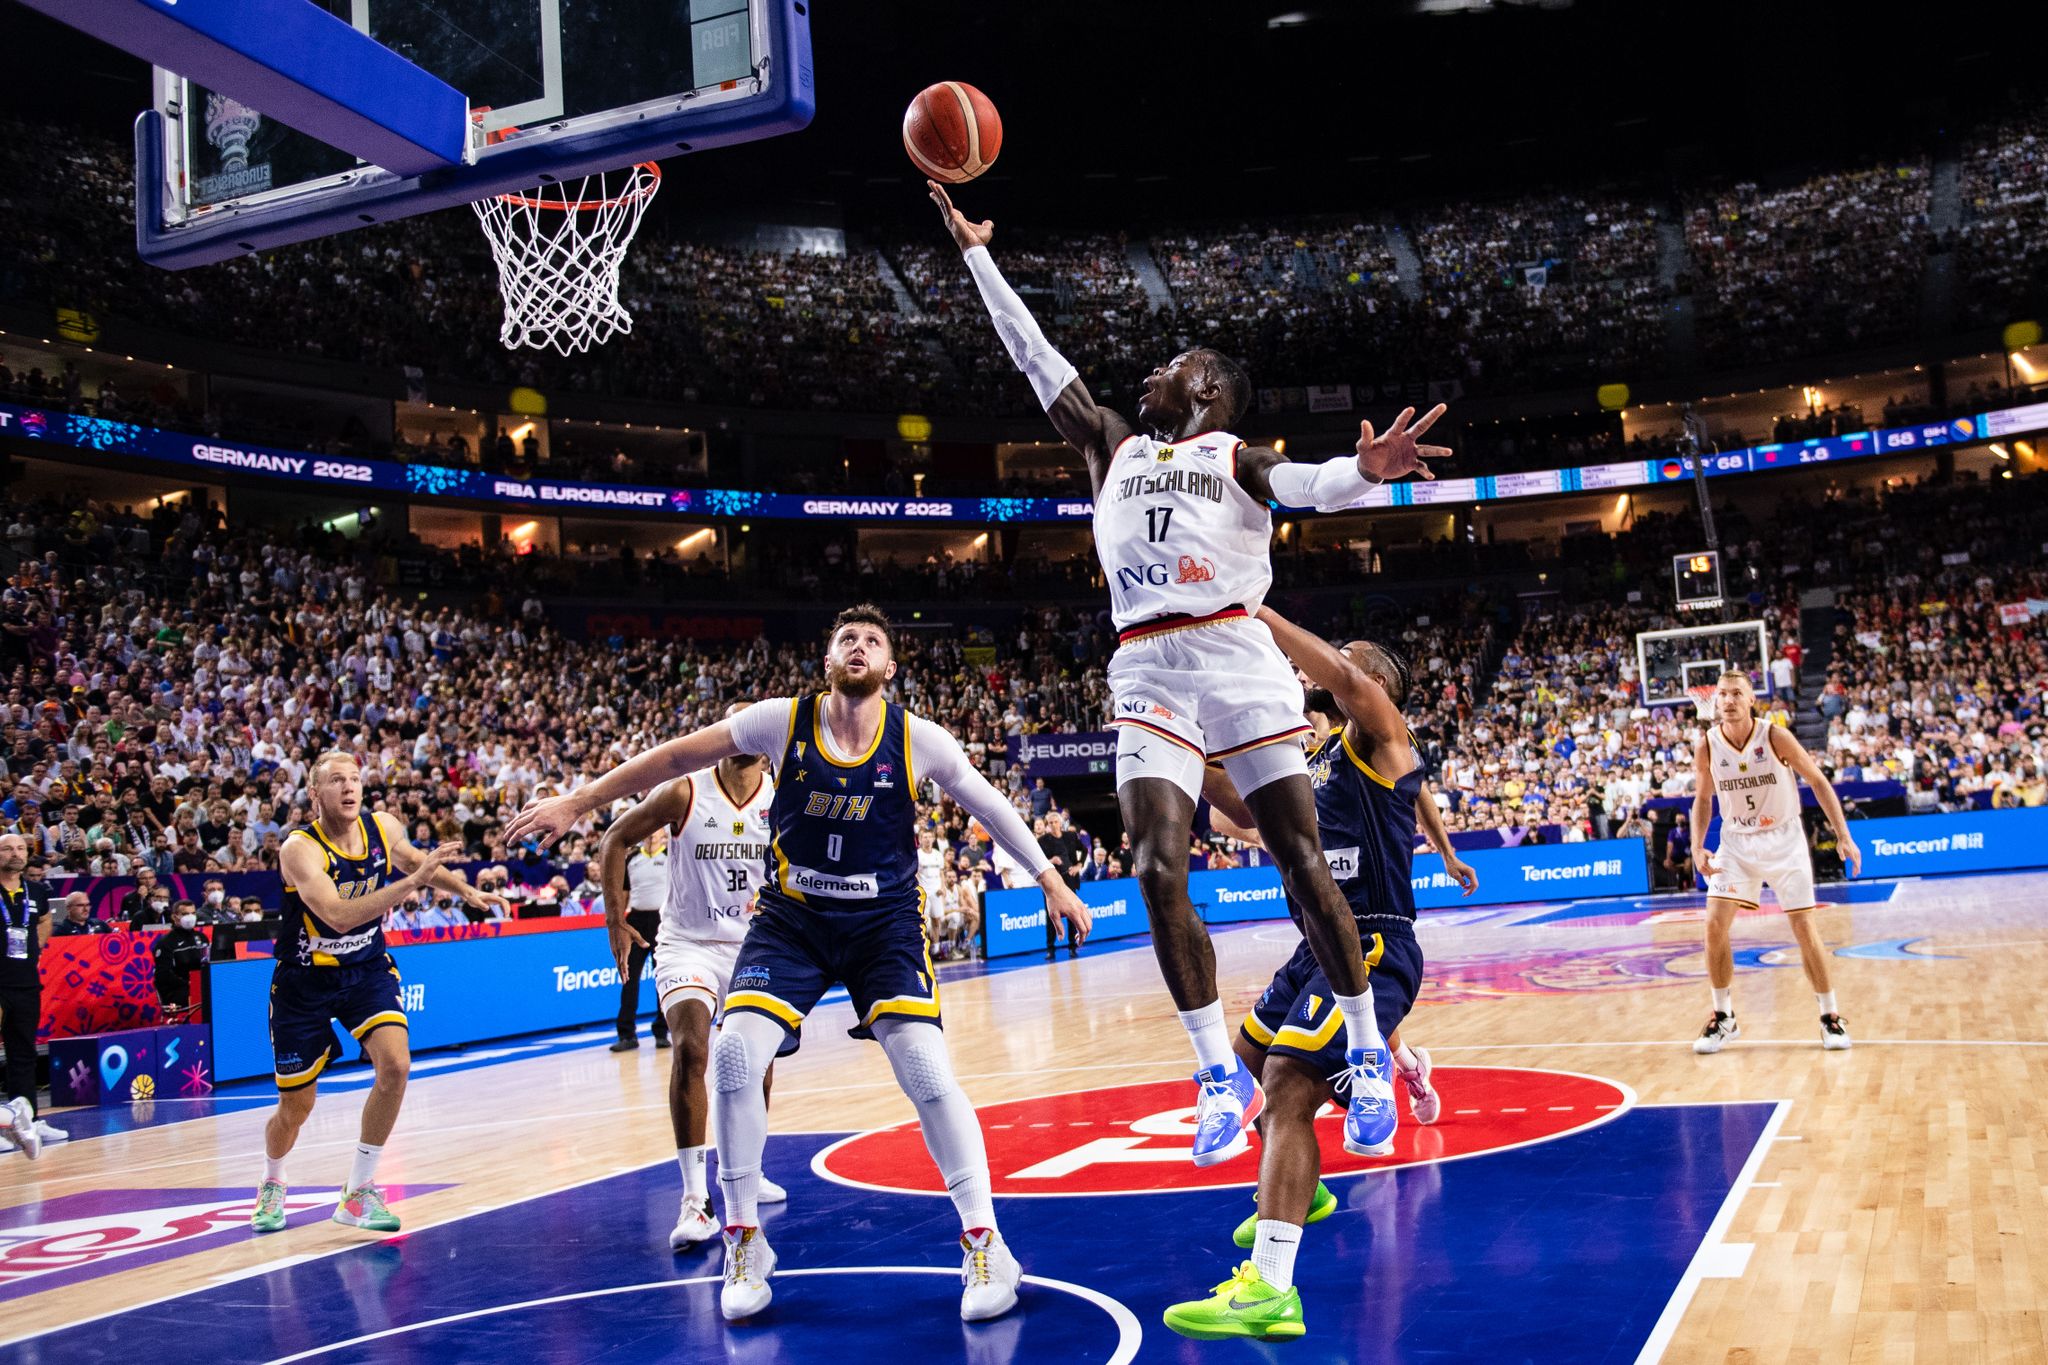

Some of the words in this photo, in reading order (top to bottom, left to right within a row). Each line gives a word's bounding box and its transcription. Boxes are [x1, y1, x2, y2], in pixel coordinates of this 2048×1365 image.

[192, 443, 306, 474] GERMANY
[312, 460, 373, 482] 2022
[494, 481, 536, 499] FIBA
[540, 486, 667, 506] EUROBASKET
[1117, 469, 1223, 504] EUTSCHLAND
[803, 500, 899, 517] GERMANY
[904, 502, 953, 517] 2022
[1057, 503, 1095, 516] FIBA
[1145, 506, 1174, 543] 17
[1115, 562, 1169, 592] ING
[1719, 772, 1778, 792] DEUTSCHLAND
[804, 791, 874, 821] BIH
[1745, 795, 1756, 811] 5
[827, 834, 843, 862] 0
[1870, 837, 1949, 857] Tencent
[1951, 832, 1984, 850] 腾讯
[727, 869, 748, 892] 32
[795, 871, 870, 893] telemach
[1520, 863, 1592, 882] Tencent
[1593, 860, 1622, 877] 腾讯
[1215, 887, 1279, 904] Tencent
[706, 904, 741, 921] ING
[1000, 912, 1038, 932] Tencent
[553, 964, 622, 992] Tencen
[664, 976, 689, 990] ING
[735, 978, 769, 989] GROUP
